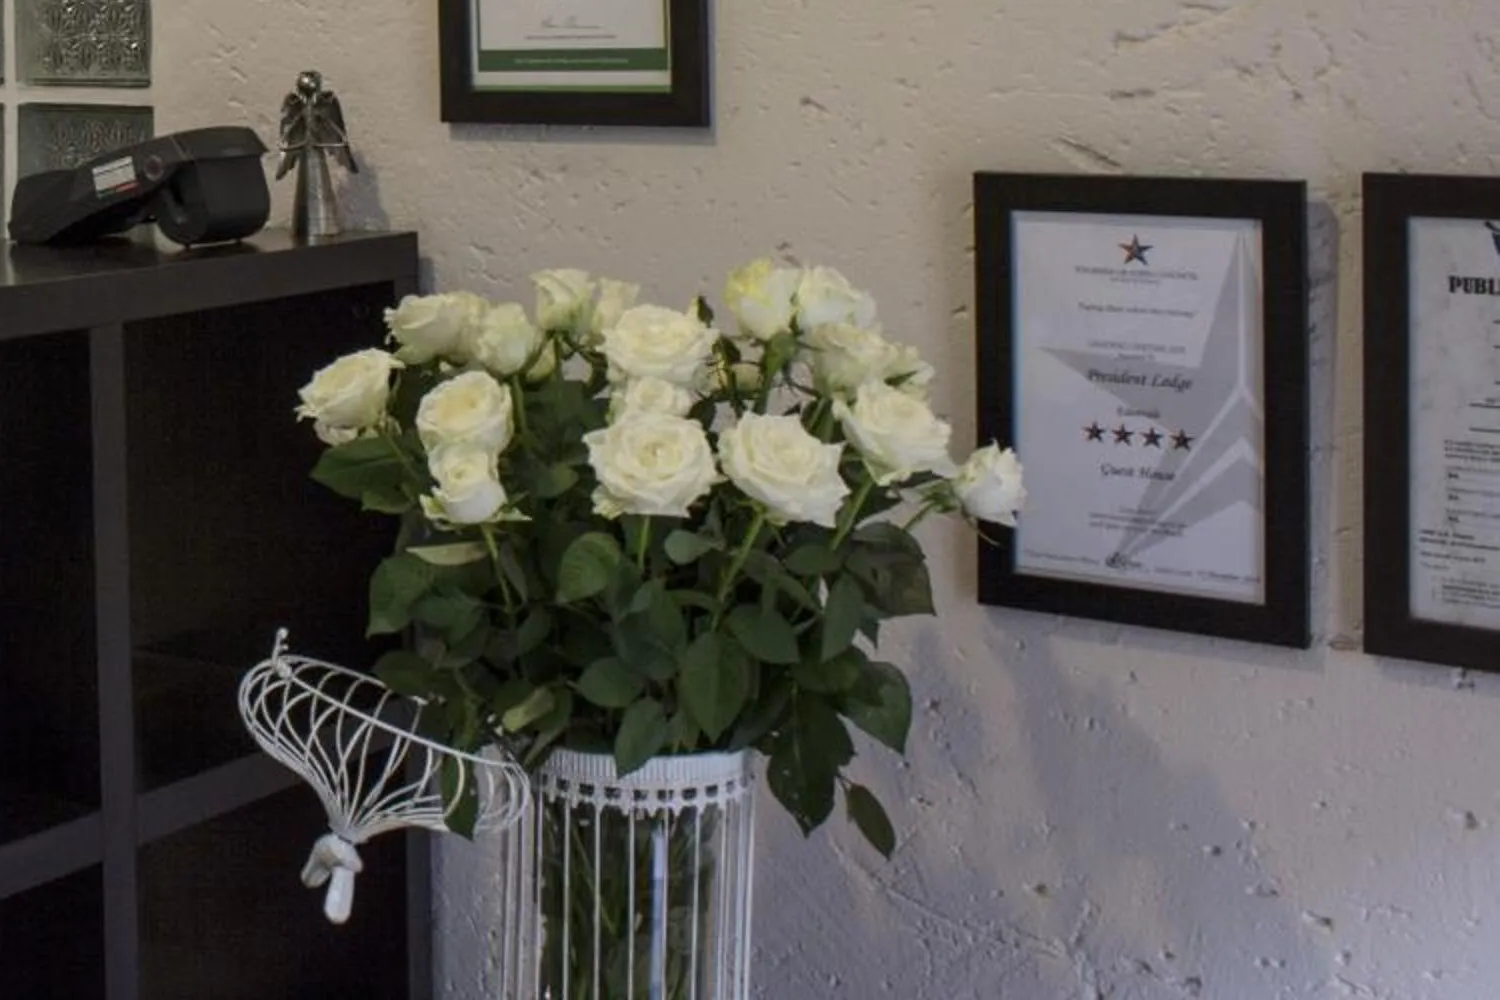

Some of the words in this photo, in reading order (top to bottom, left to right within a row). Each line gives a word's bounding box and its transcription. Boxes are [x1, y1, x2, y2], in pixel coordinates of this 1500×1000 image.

[1448, 275, 1500, 295] PUBL
[1087, 368, 1147, 388] President
[1151, 373, 1193, 393] Lodge
